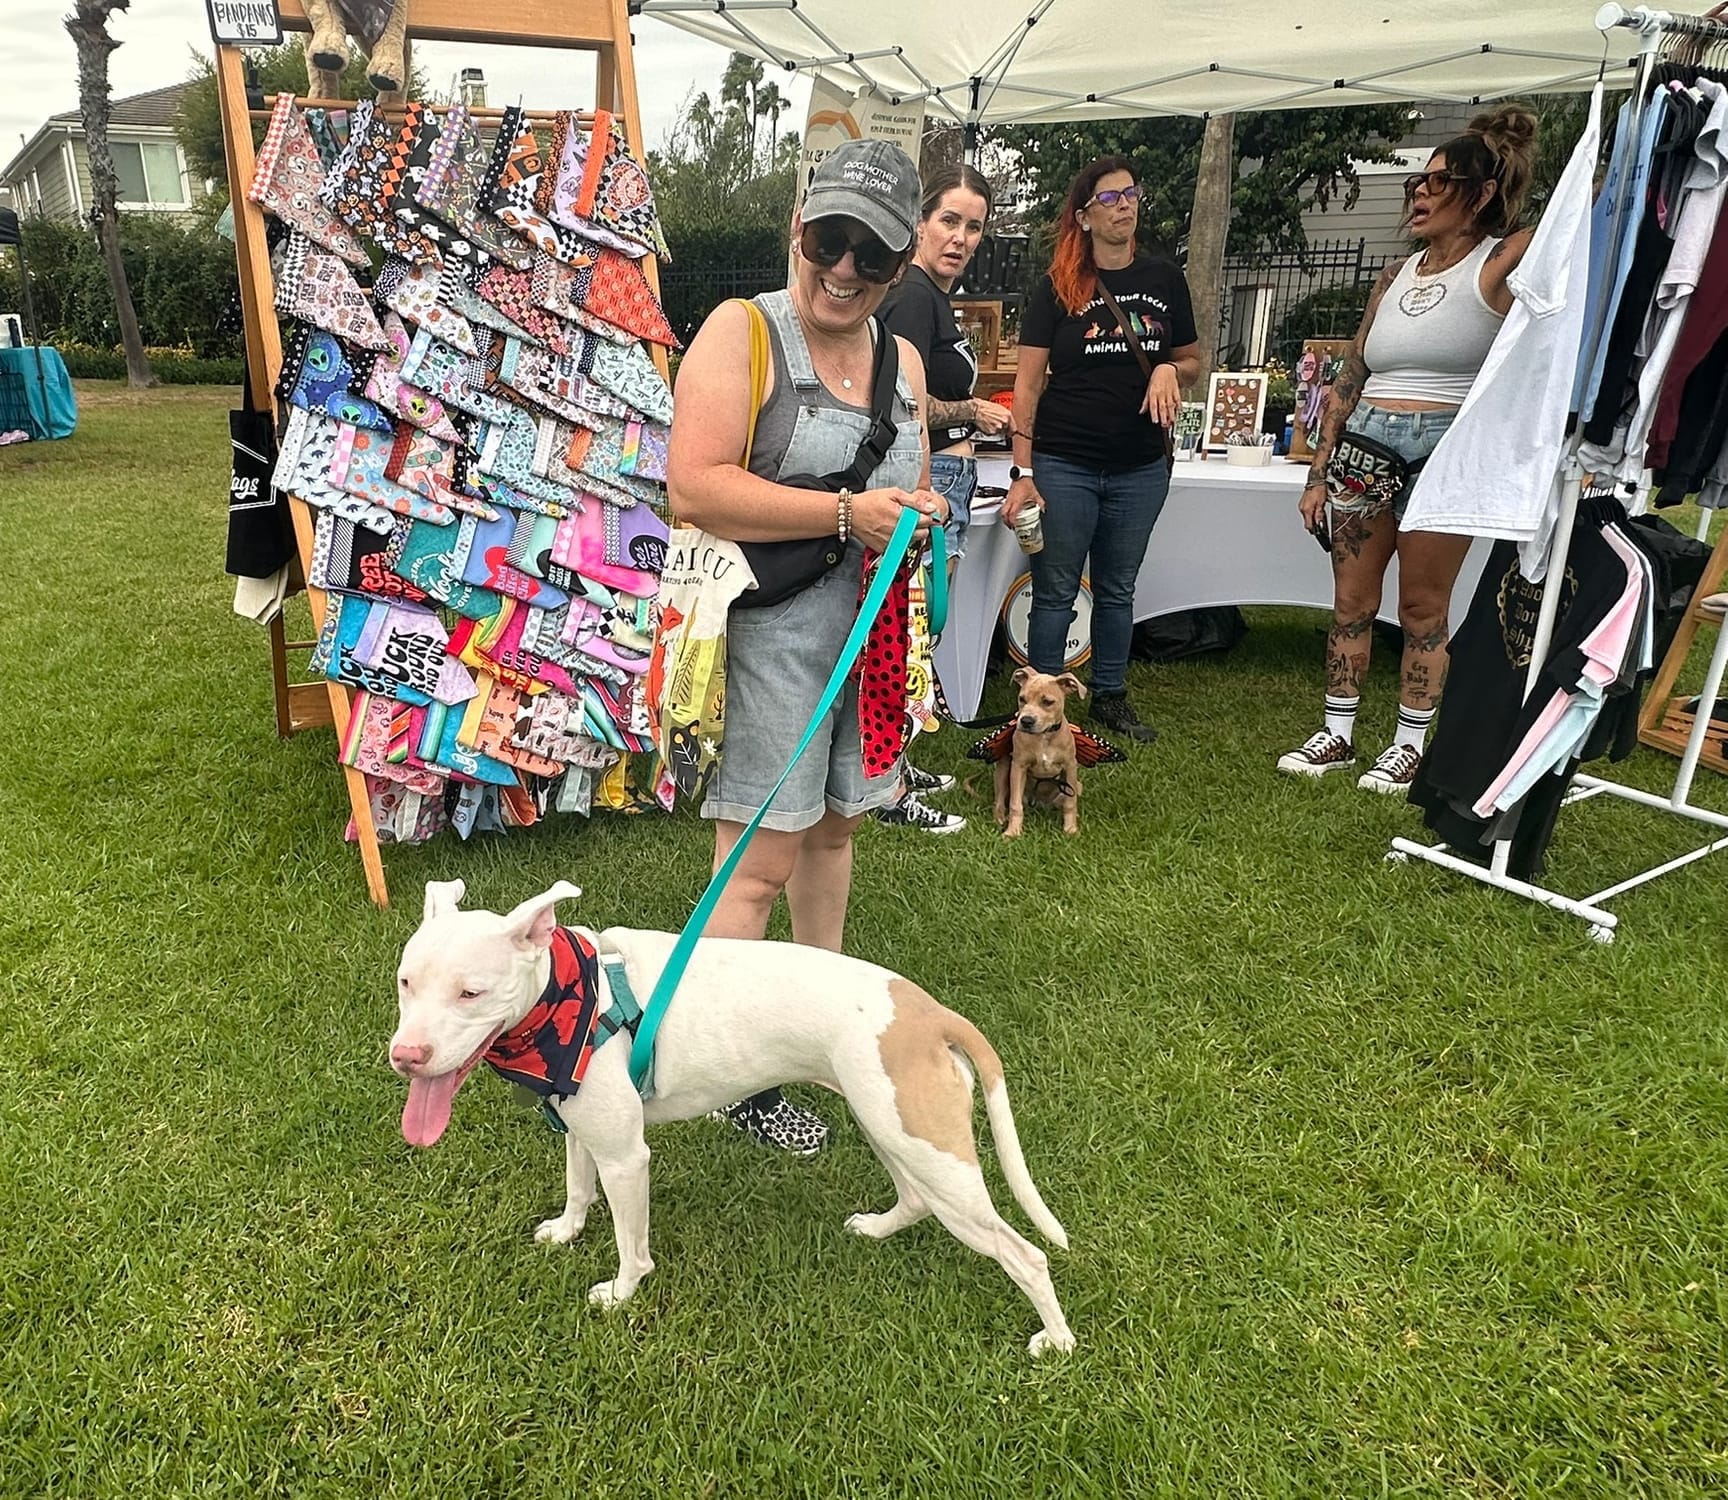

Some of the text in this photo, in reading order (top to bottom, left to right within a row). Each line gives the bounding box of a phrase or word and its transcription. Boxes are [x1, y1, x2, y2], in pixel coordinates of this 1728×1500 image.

[214, 1, 275, 26] BANDANAS
[236, 22, 258, 38] $15
[842, 169, 893, 194] WINE LOVER
[843, 160, 899, 185] DOG MOTHER
[1141, 293, 1169, 313] LOCAL
[1084, 339, 1161, 355] ANIMAL ARE
[1336, 441, 1392, 477] BUBZ
[231, 475, 260, 500] ags
[457, 585, 474, 608] GIVE
[337, 642, 367, 690] UCK
[378, 626, 418, 684] UCK
[407, 633, 434, 693] ROUND
[421, 667, 440, 695] IND
